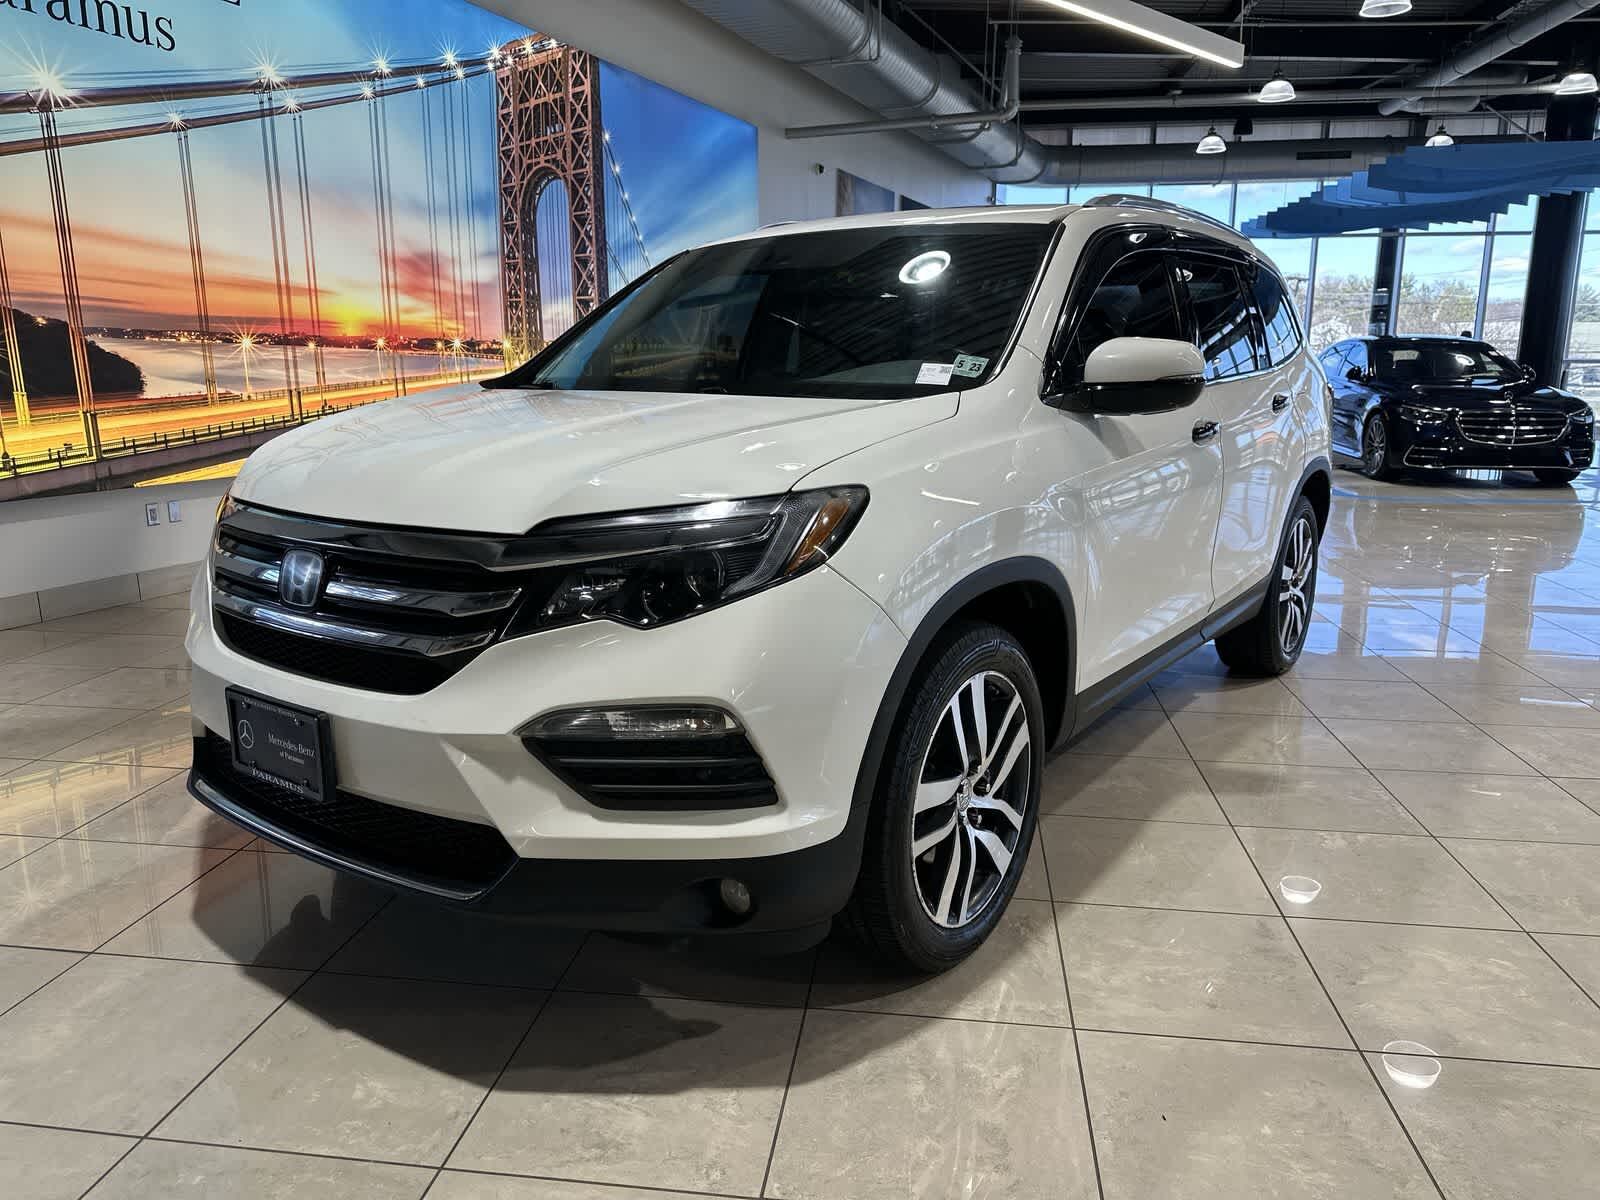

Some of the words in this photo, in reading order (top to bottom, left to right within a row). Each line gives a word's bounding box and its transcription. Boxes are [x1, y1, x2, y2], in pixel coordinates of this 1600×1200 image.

[957, 360, 965, 369] 5
[968, 362, 982, 372] 23
[251, 766, 305, 794] PARAMUS
